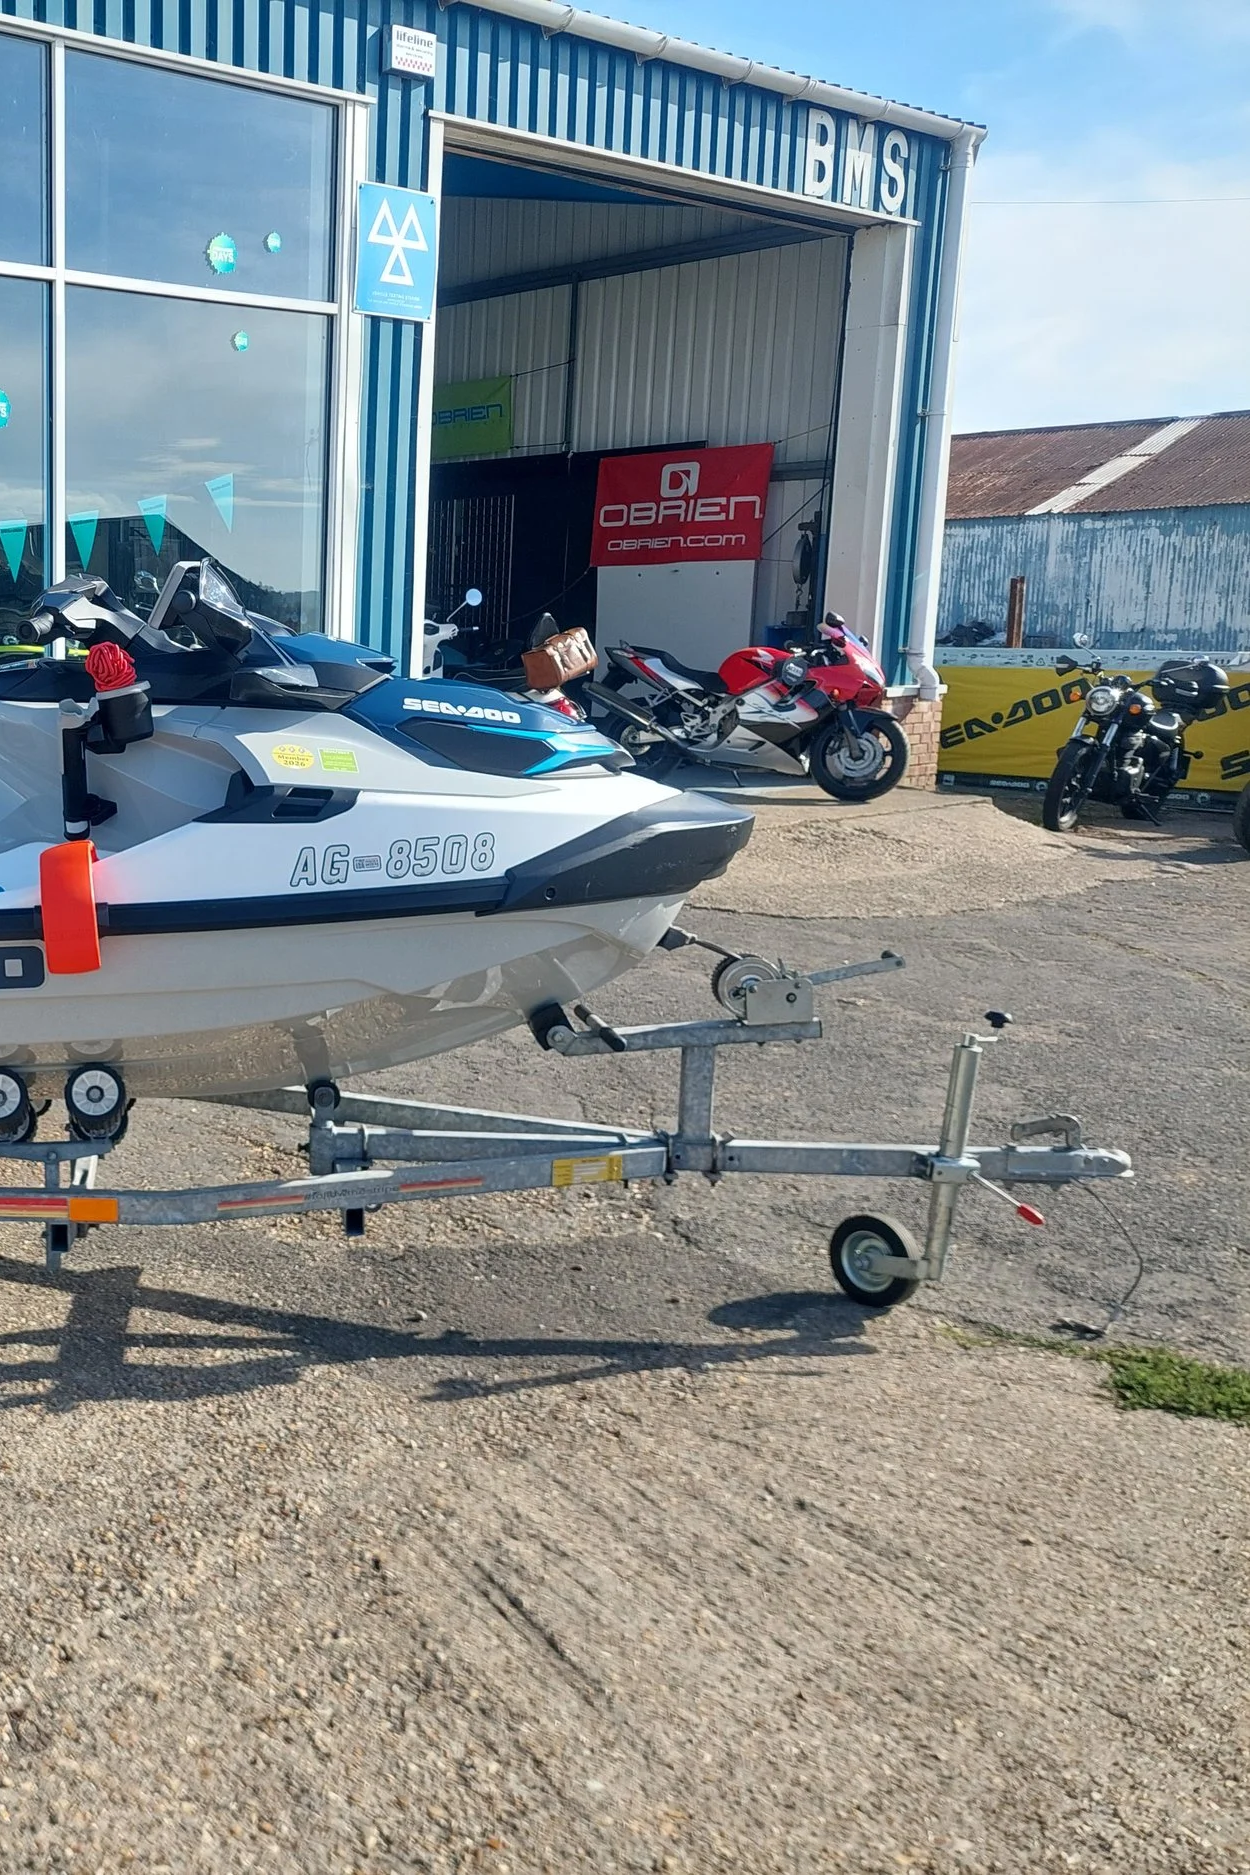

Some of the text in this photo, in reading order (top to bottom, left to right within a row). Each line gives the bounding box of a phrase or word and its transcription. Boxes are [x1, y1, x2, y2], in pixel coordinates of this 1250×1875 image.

[396, 30, 433, 48] lifeline
[804, 107, 909, 212] BMS
[433, 403, 503, 426] BRIEN
[599, 495, 761, 528] OBRIEN
[607, 534, 746, 551] OBRIEN.COM
[278, 754, 309, 762] Member
